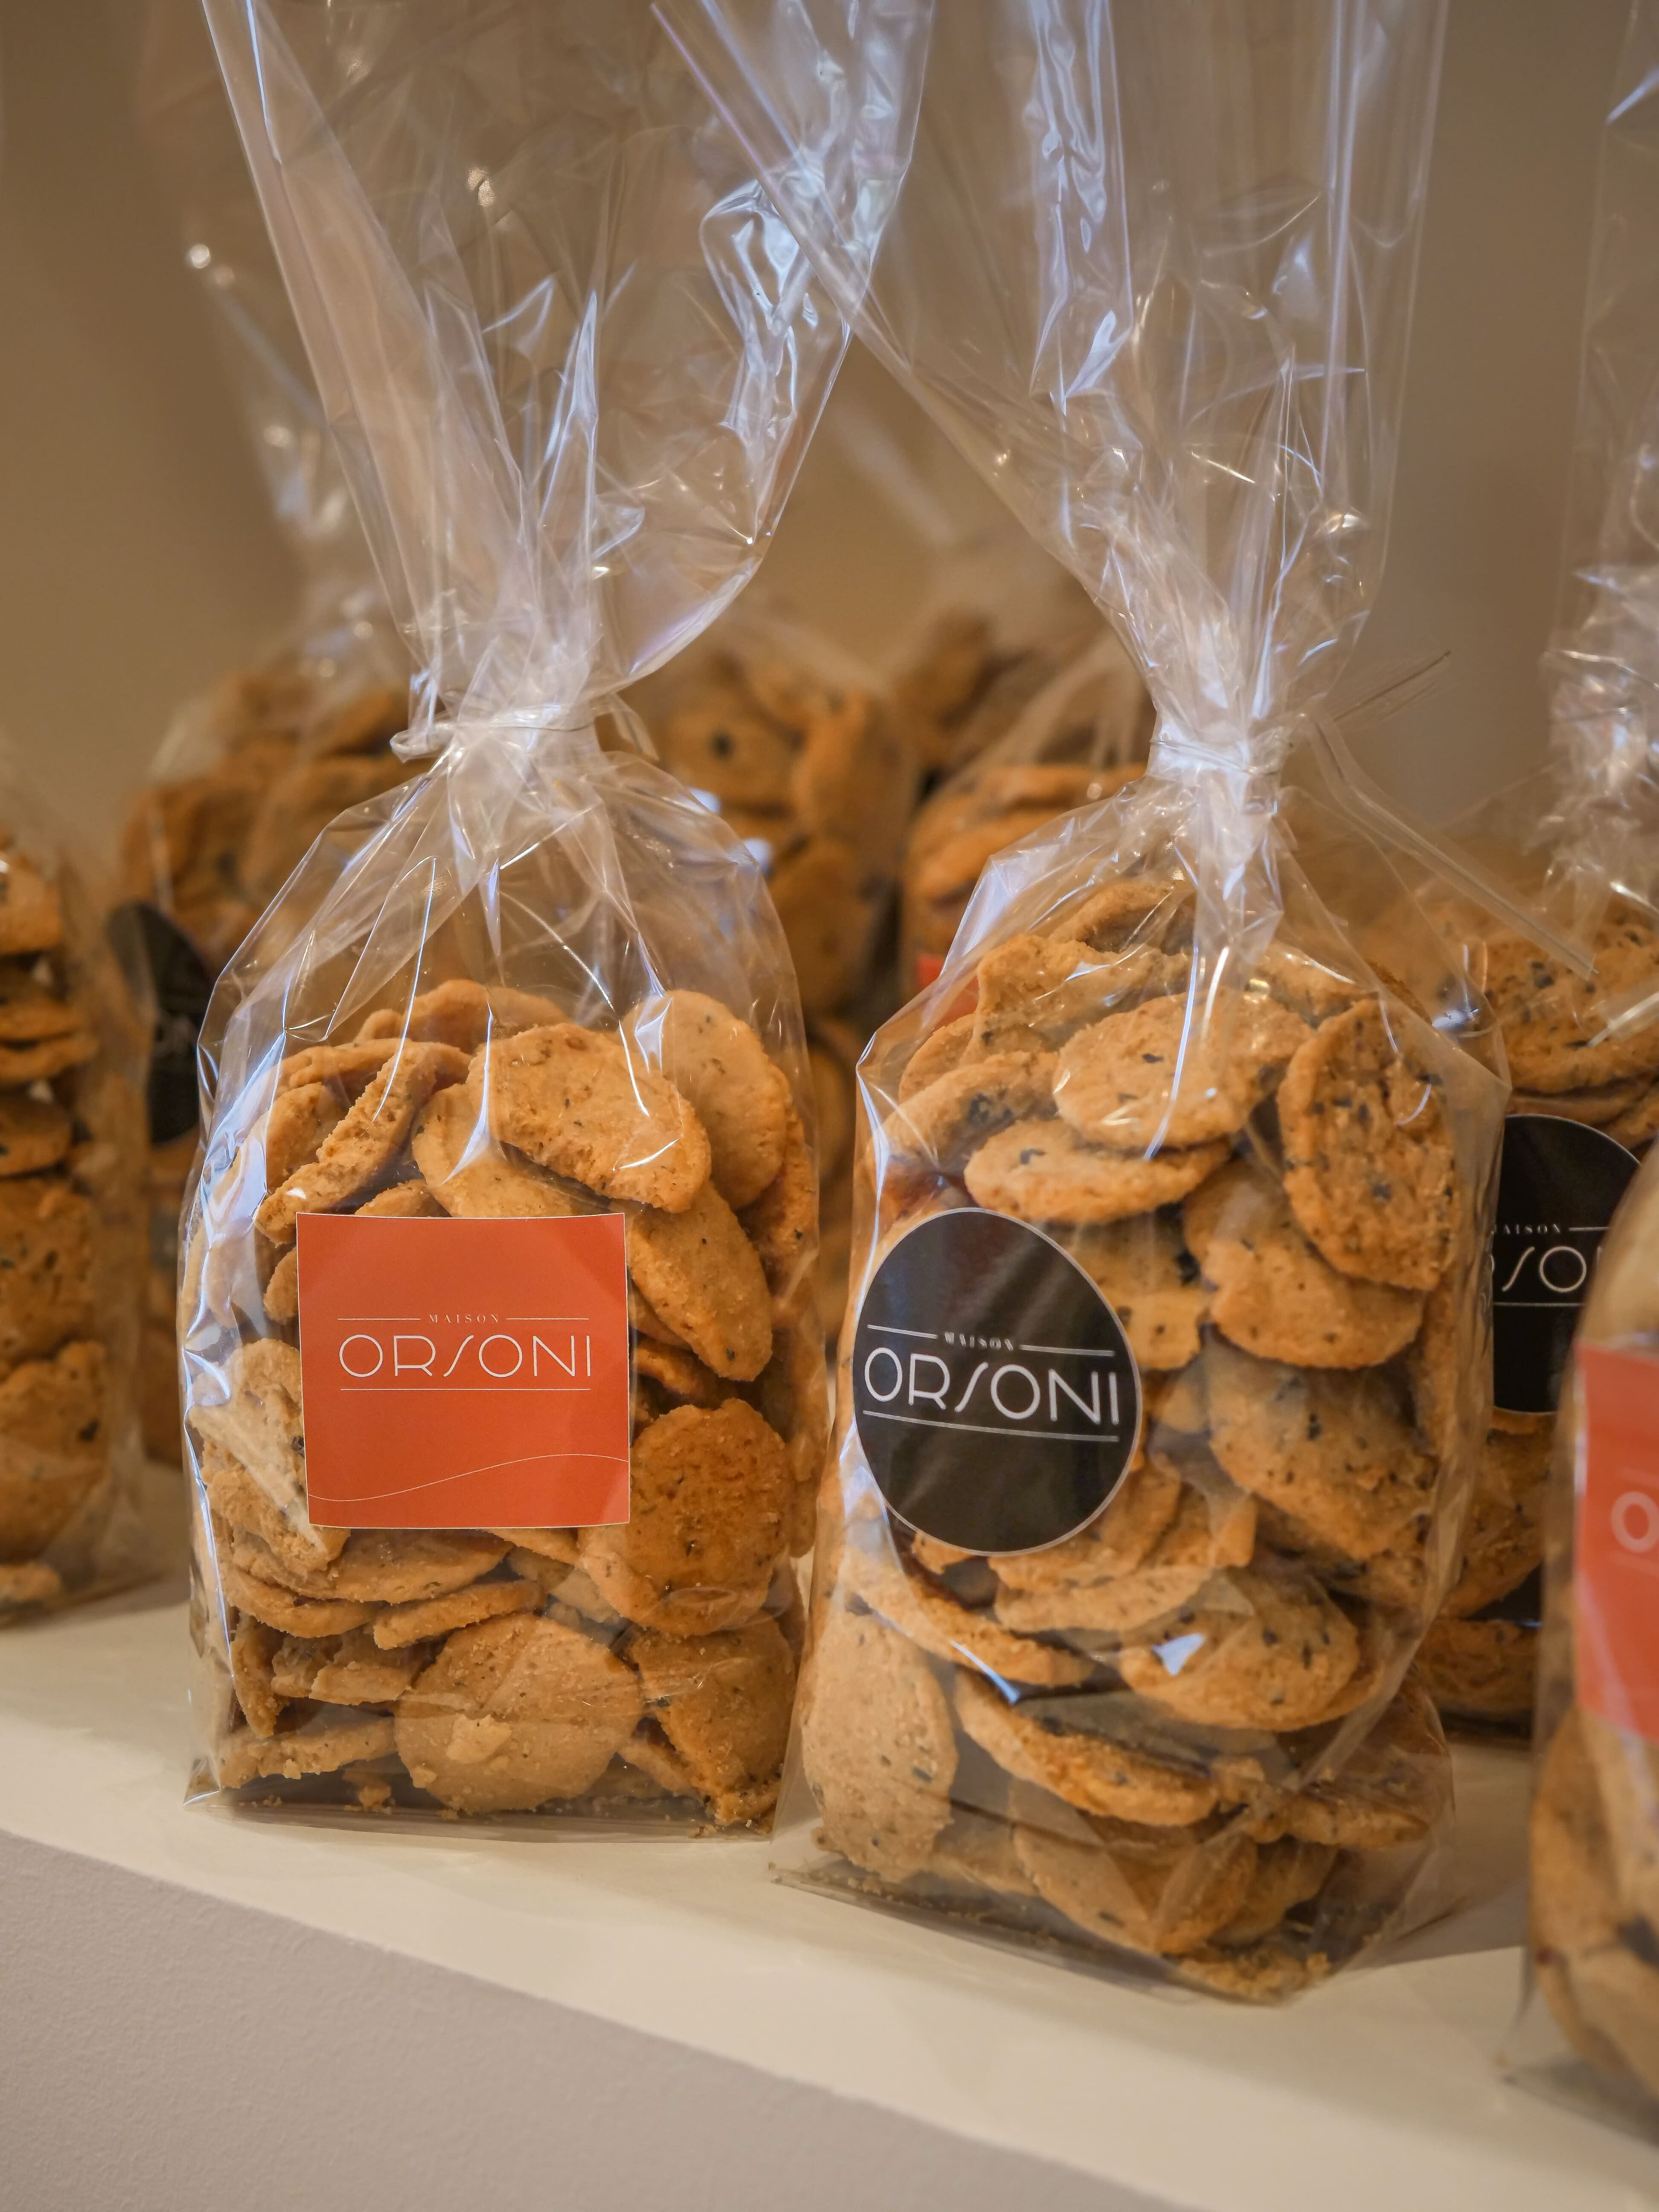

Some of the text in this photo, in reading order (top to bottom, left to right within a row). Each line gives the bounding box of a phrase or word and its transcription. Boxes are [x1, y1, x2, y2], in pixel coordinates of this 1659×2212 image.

[428, 1313, 498, 1324] MAISON
[339, 1334, 591, 1378] ORSONI
[864, 1347, 1119, 1425] ORSONI
